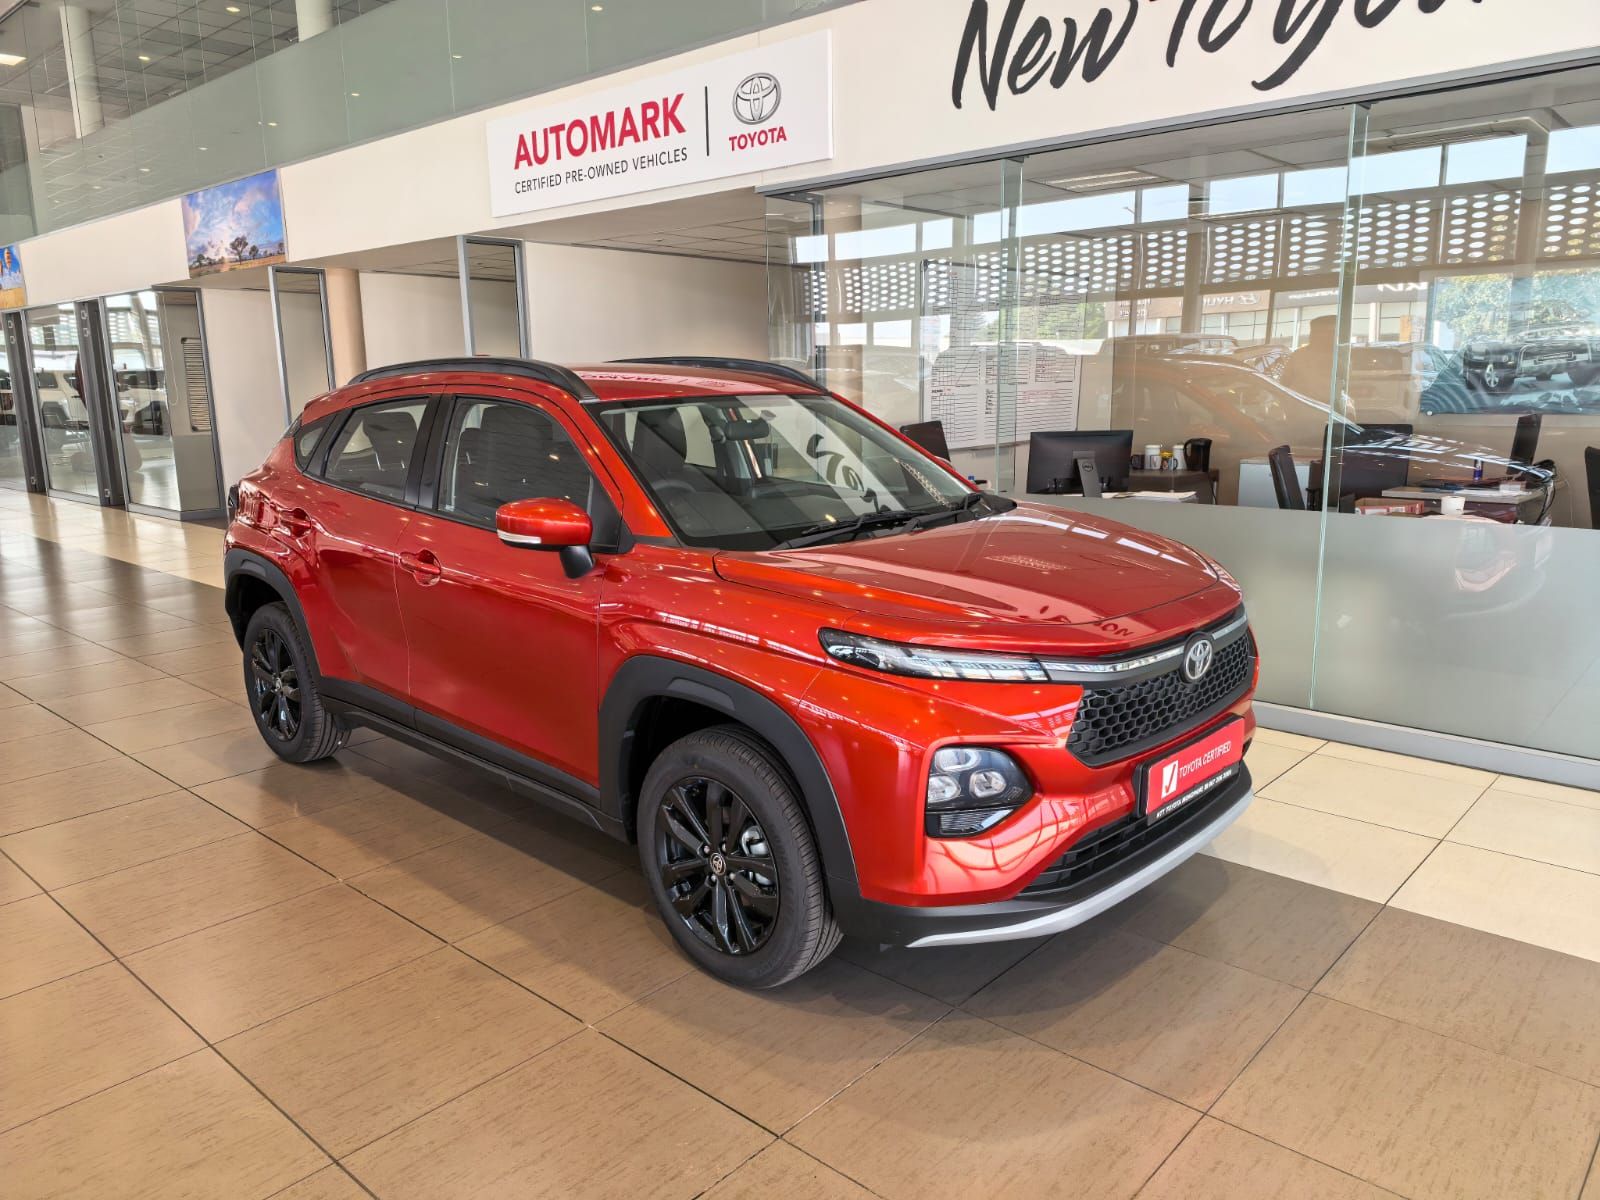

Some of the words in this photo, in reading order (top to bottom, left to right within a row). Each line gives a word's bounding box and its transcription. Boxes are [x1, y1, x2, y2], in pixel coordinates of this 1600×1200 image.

[951, 0, 1138, 111] New
[513, 93, 687, 170] AUTOMARK
[728, 125, 788, 152] TOYOTA
[514, 173, 562, 194] CERTIFIED
[565, 159, 629, 184] PRE-OWNED
[632, 147, 688, 171] VEHICLES
[1179, 756, 1202, 778] TOYOTA
[1202, 740, 1232, 765] CERTIFIED
